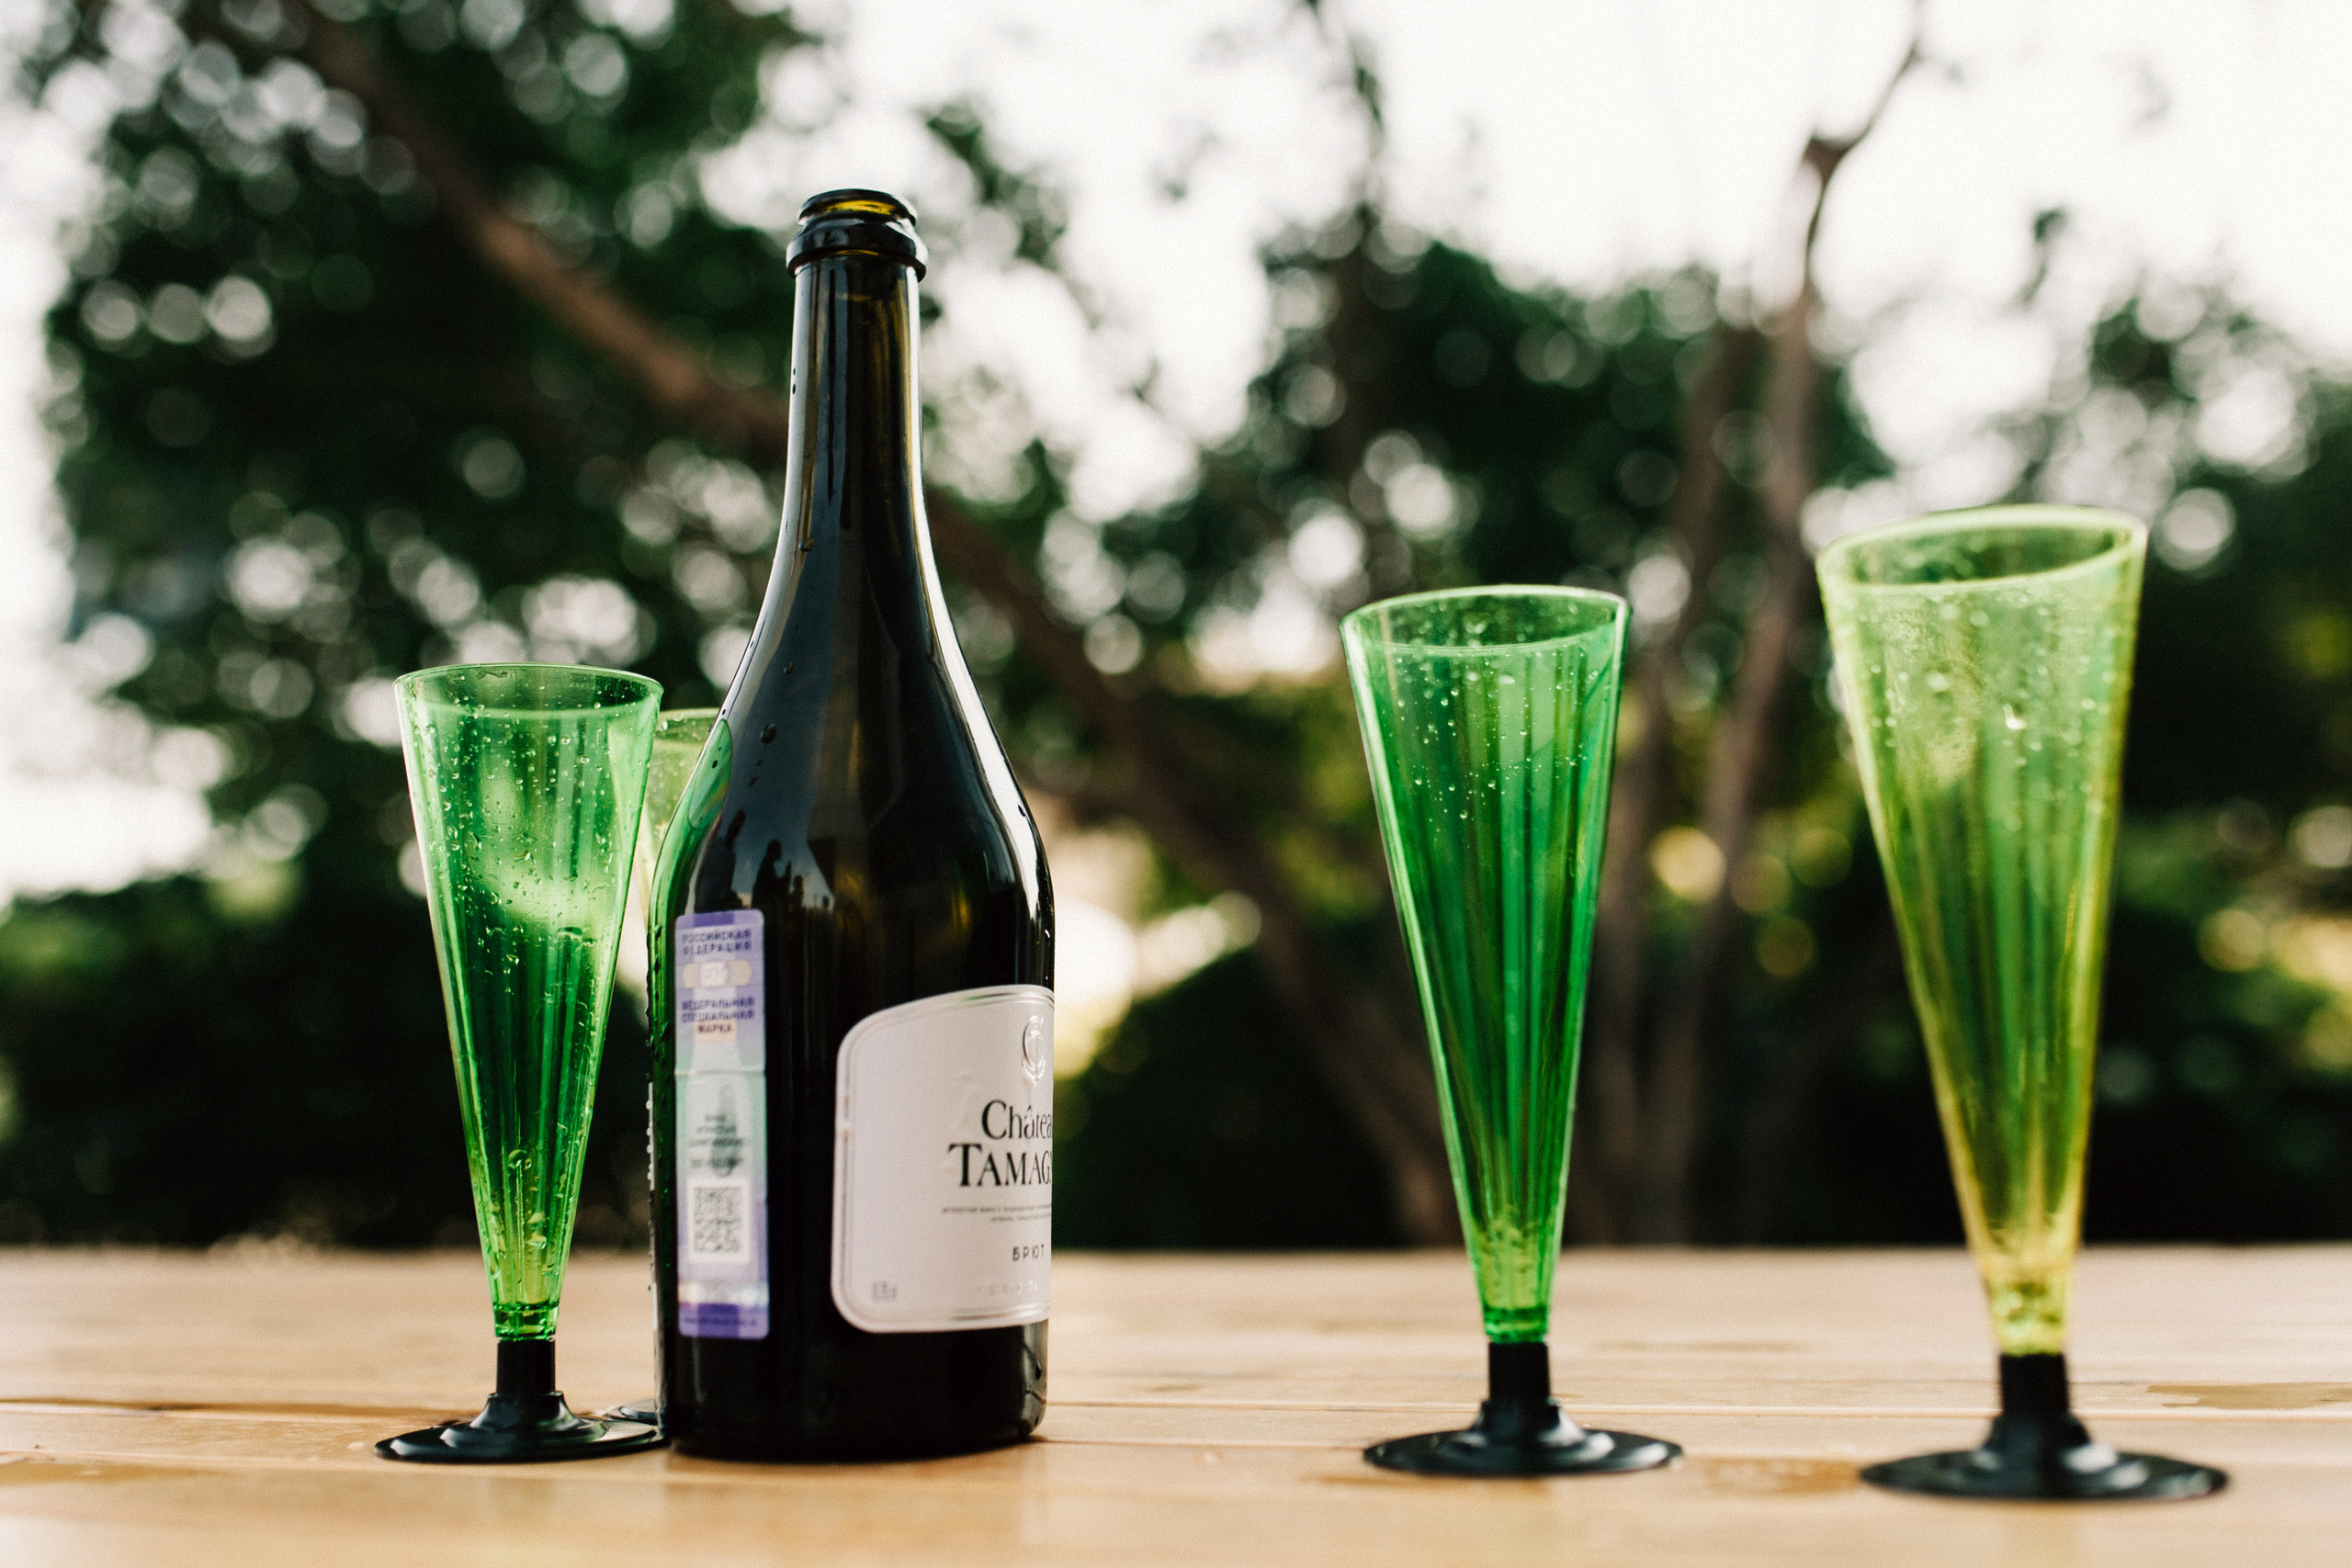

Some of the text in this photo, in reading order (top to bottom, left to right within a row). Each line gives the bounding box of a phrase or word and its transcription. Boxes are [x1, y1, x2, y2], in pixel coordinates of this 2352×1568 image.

[682, 929, 752, 944] РОССИЙСКАЯ
[947, 1142, 1052, 1187] TAMAG
[1012, 1244, 1046, 1262] БРЮТ
